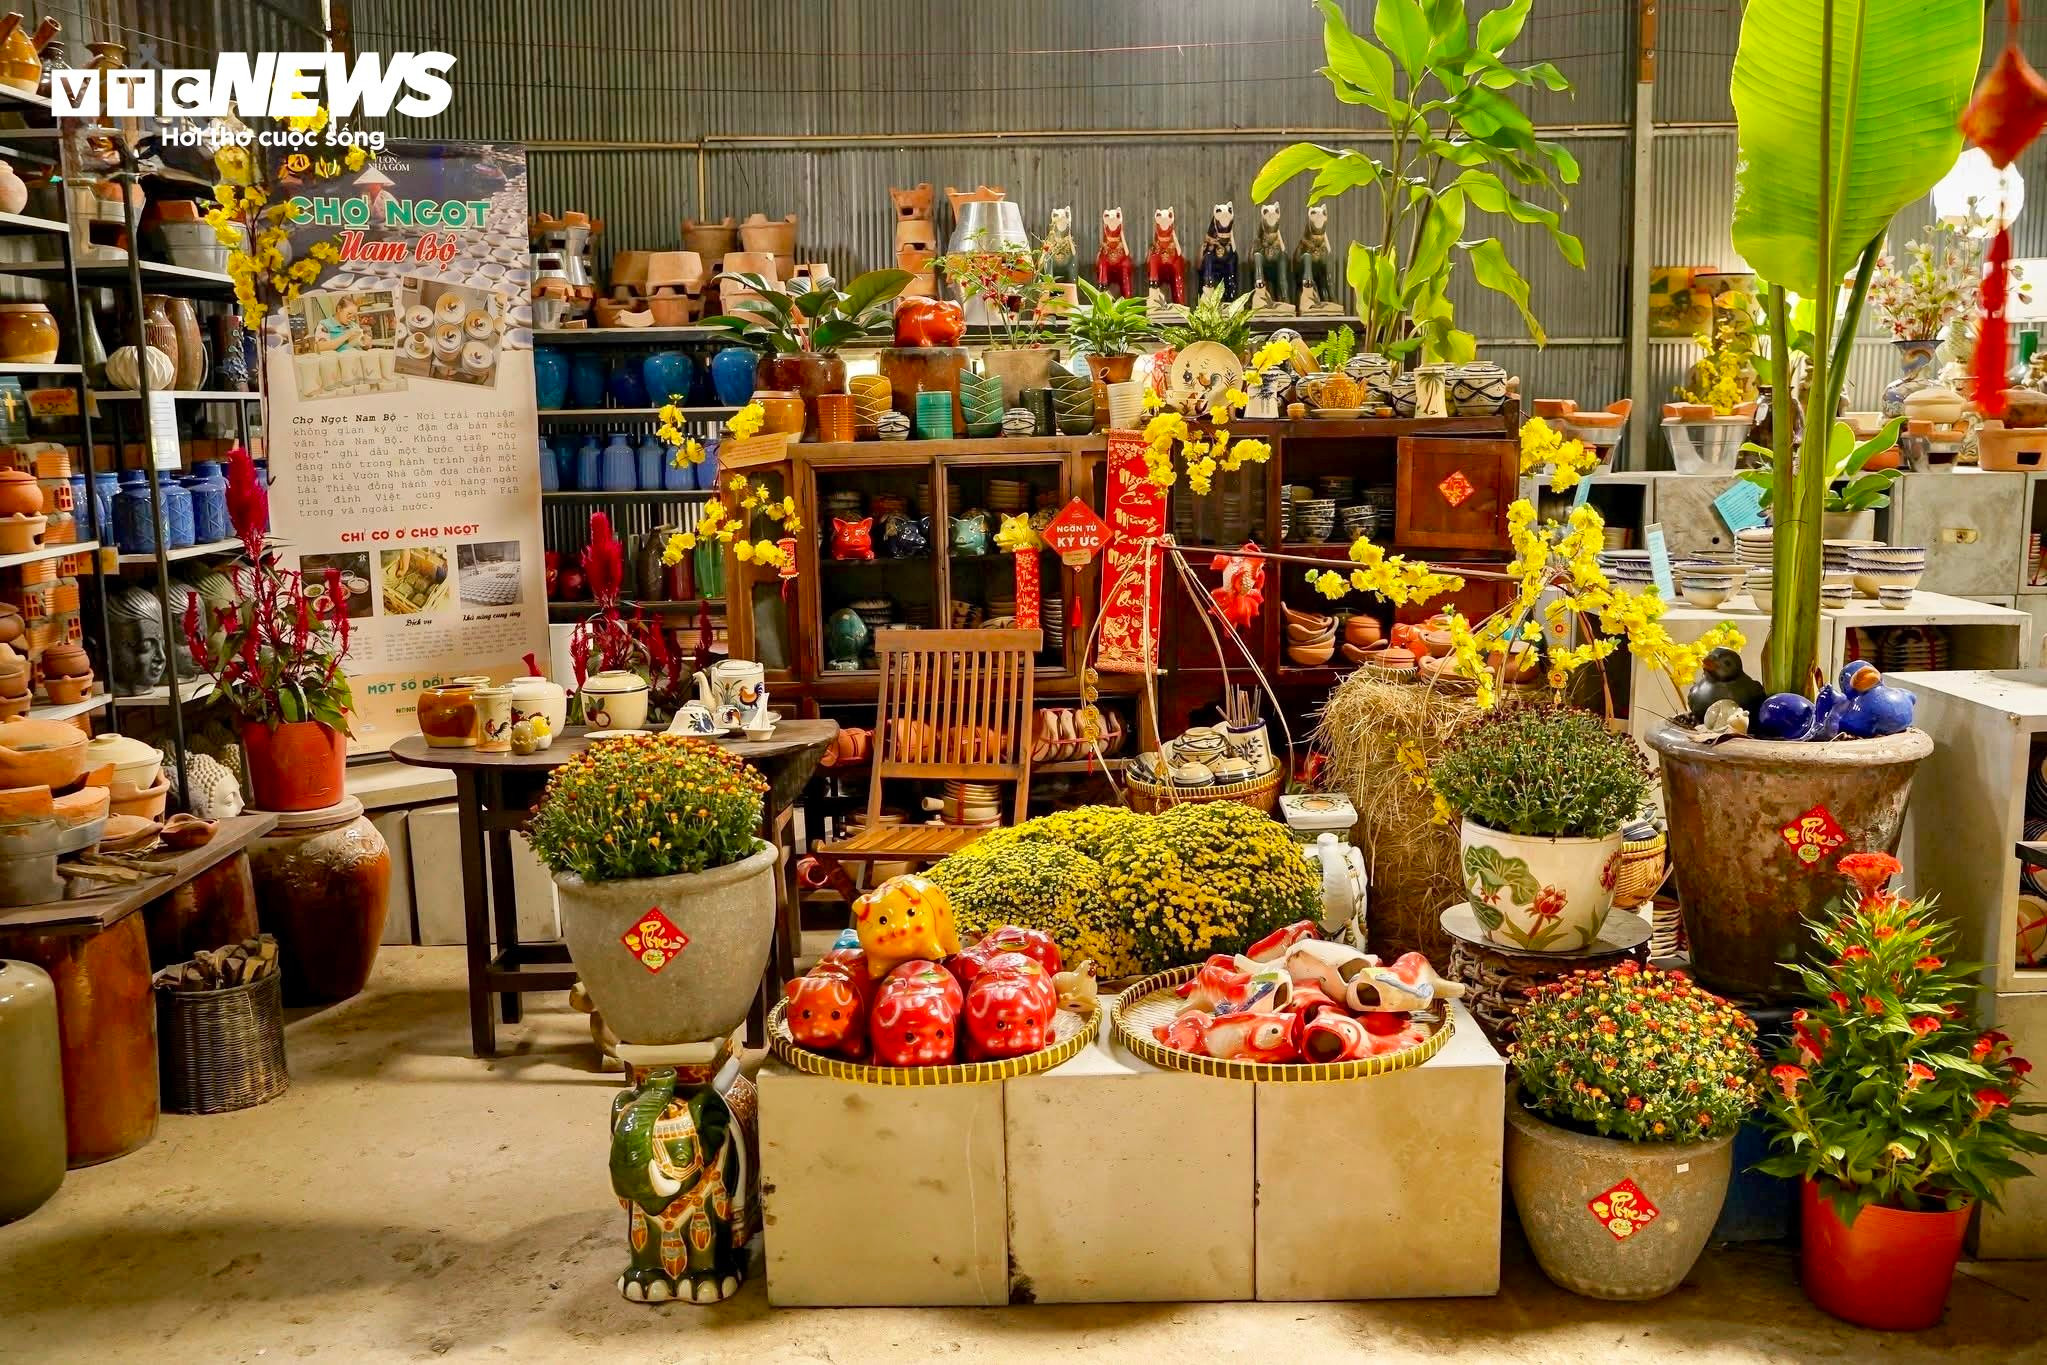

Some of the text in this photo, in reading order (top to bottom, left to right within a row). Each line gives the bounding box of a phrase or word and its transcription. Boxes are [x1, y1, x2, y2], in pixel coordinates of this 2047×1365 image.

[288, 194, 492, 231] CHỢ NGỌT
[338, 230, 460, 272] Nam Bộ
[292, 416, 314, 425] Chợ
[321, 415, 348, 425] Ngọt
[355, 414, 376, 422] Nam
[383, 413, 397, 422] Bộ
[476, 409, 515, 419] nghiệm
[293, 427, 328, 436] không
[337, 427, 364, 435] gian
[418, 423, 438, 432] đậm
[496, 419, 516, 429] sắc
[293, 439, 315, 447] văn
[355, 437, 375, 446] Nam
[413, 435, 446, 443] Không
[455, 433, 482, 442] gian
[339, 449, 359, 459] ghi
[398, 447, 417, 456] một
[427, 446, 454, 454] bước
[463, 444, 489, 453] tiếp
[360, 460, 392, 469] trong
[400, 458, 425, 467] hành
[433, 456, 465, 465] trình
[498, 454, 517, 462] một
[296, 474, 324, 484] thập
[353, 471, 380, 480] Vườn
[387, 469, 406, 478] Nhà
[413, 468, 433, 477] Gốm
[440, 467, 459, 475] đưa
[326, 484, 360, 493] Thiêu
[367, 481, 394, 491] đồng
[401, 480, 427, 489] hành
[434, 478, 453, 487] với
[460, 477, 486, 486] hàng
[298, 497, 319, 507] gia
[333, 495, 361, 504] đình
[375, 493, 401, 502] Việt
[415, 490, 441, 499] cùng
[454, 488, 487, 498] ngành
[299, 508, 334, 518] trong
[341, 506, 355, 515] và
[361, 505, 395, 515] ngoài
[411, 526, 438, 538] CHỢ
[444, 524, 480, 536] NGỌT
[1057, 531, 1100, 547] KÝ ỨC
[368, 682, 396, 694] MỘT
[401, 676, 417, 691] SỐ
